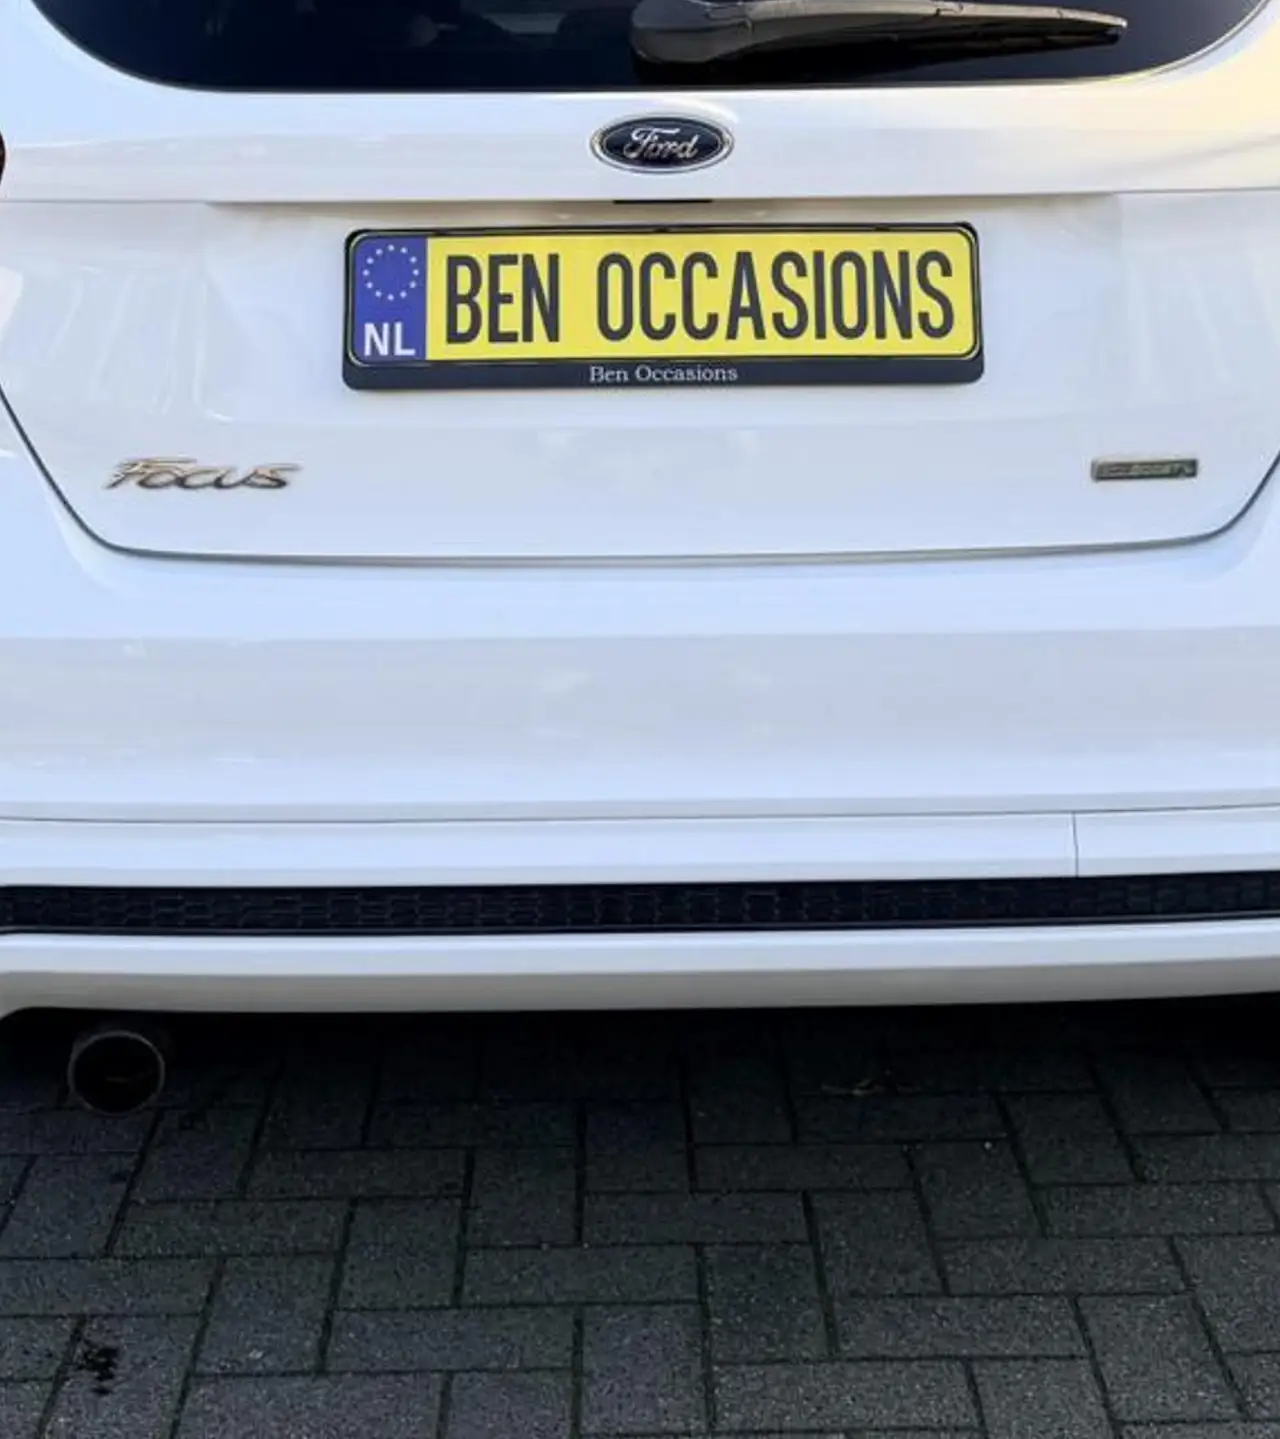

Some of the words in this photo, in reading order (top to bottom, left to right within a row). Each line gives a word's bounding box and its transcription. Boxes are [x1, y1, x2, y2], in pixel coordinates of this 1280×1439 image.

[623, 127, 700, 160] Ford
[445, 253, 560, 344] BEN
[596, 250, 954, 340] OCCASIONS
[363, 323, 415, 357] NL
[589, 364, 629, 382] Ben
[635, 363, 738, 382] Occasions
